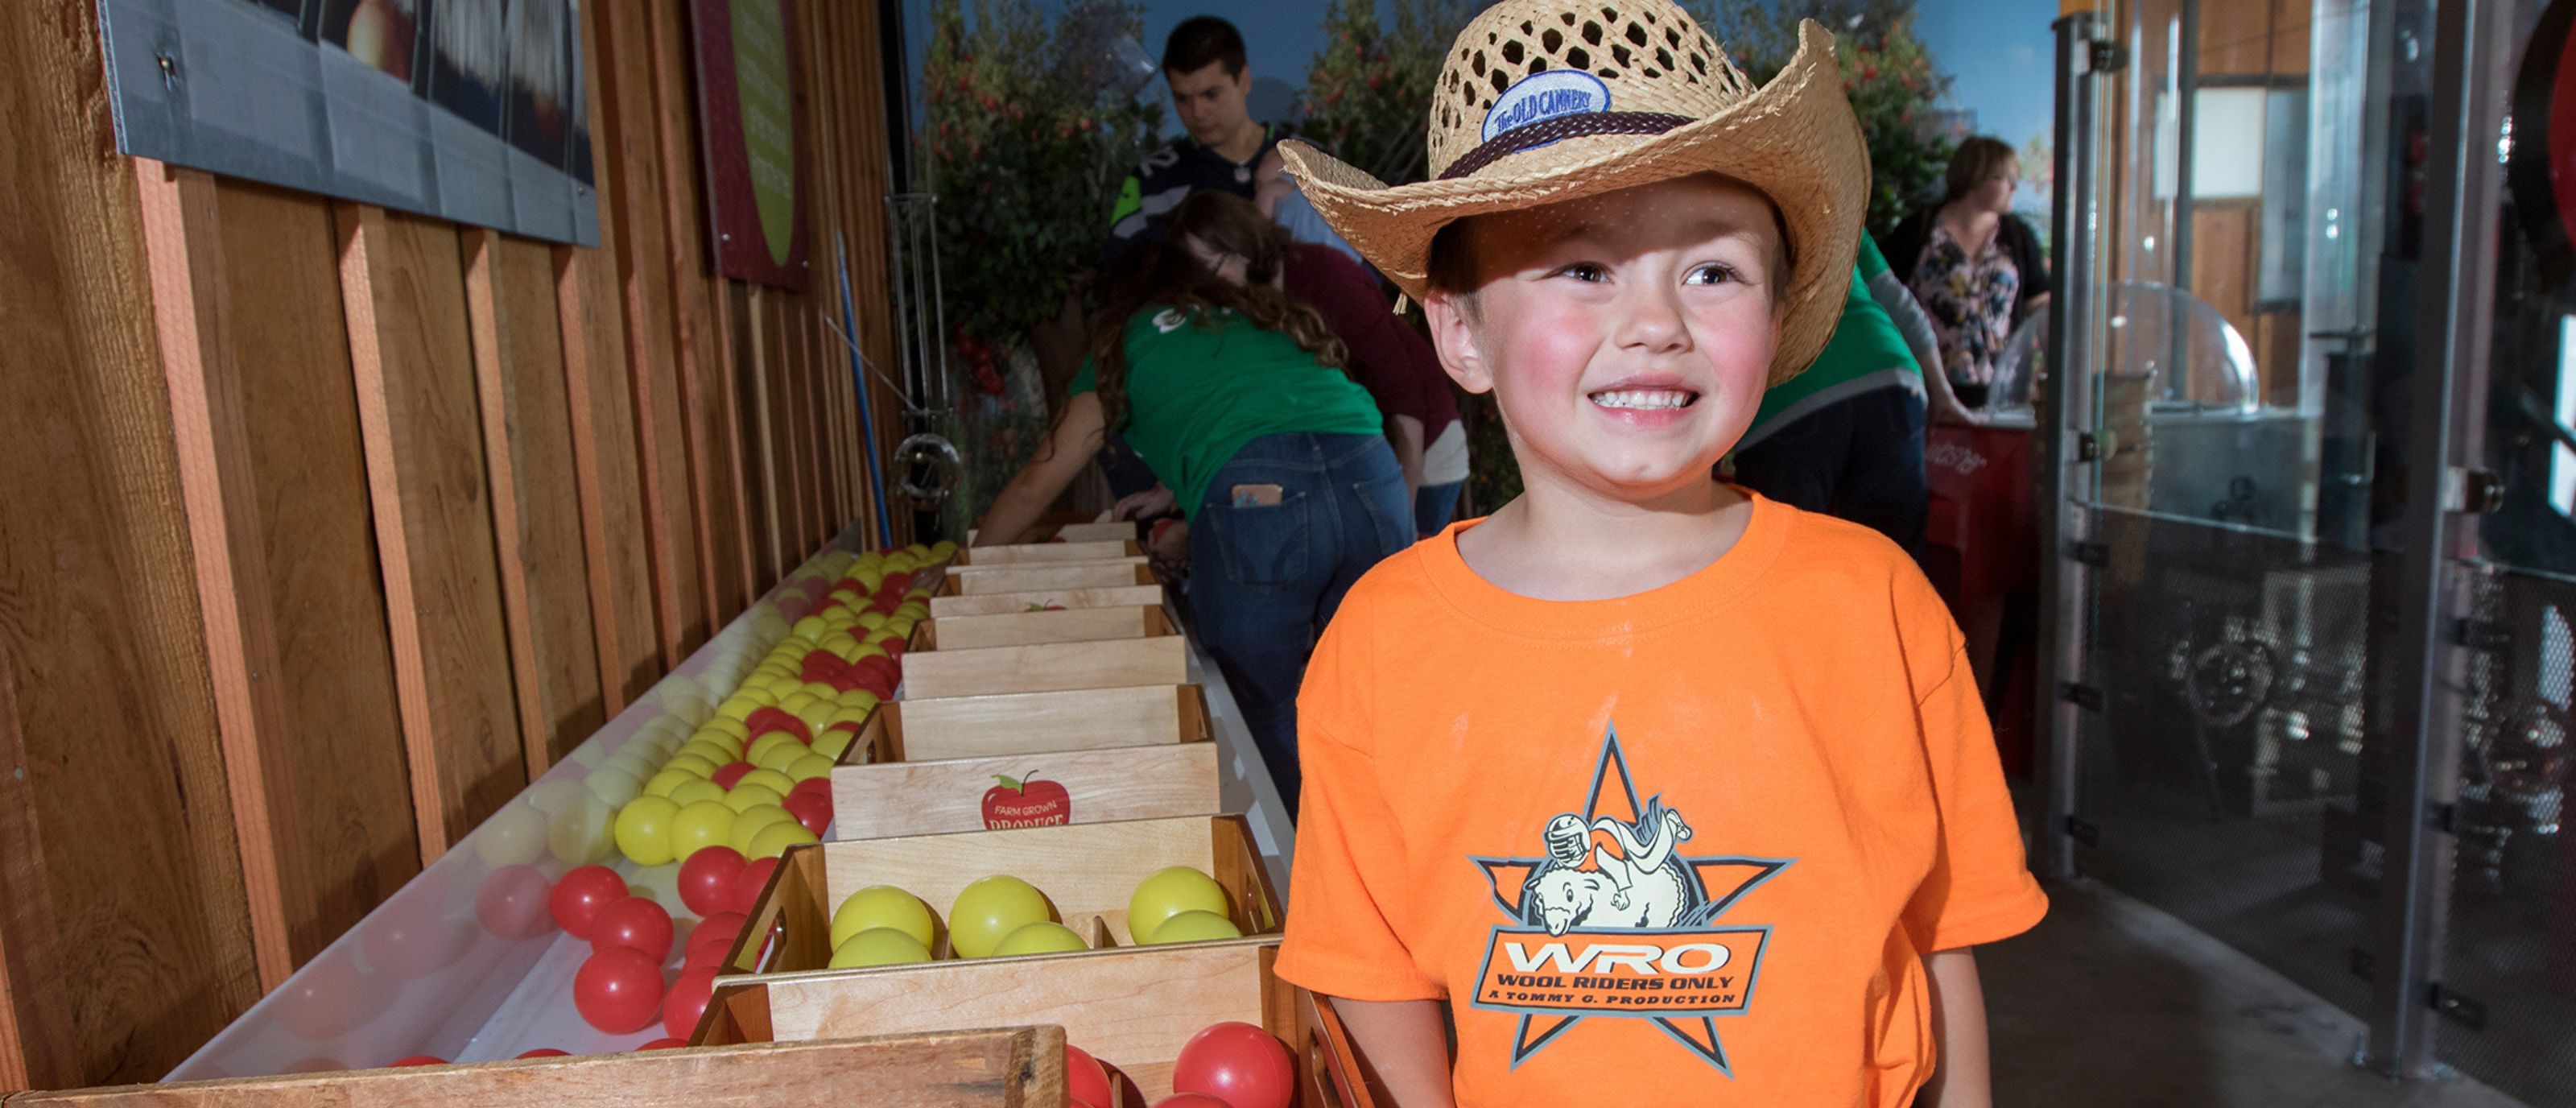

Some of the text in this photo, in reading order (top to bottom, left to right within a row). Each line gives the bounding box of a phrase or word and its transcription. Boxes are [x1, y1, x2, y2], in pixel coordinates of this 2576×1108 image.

[1495, 89, 1591, 131] The OLD CANNERY
[994, 800, 1057, 816] FARM GROWN
[1504, 942, 1732, 974] WRO
[1497, 974, 1734, 990] WOOL RIDERS ONLY
[1488, 990, 1736, 1005] A TOMMY G. PRODUCTION
